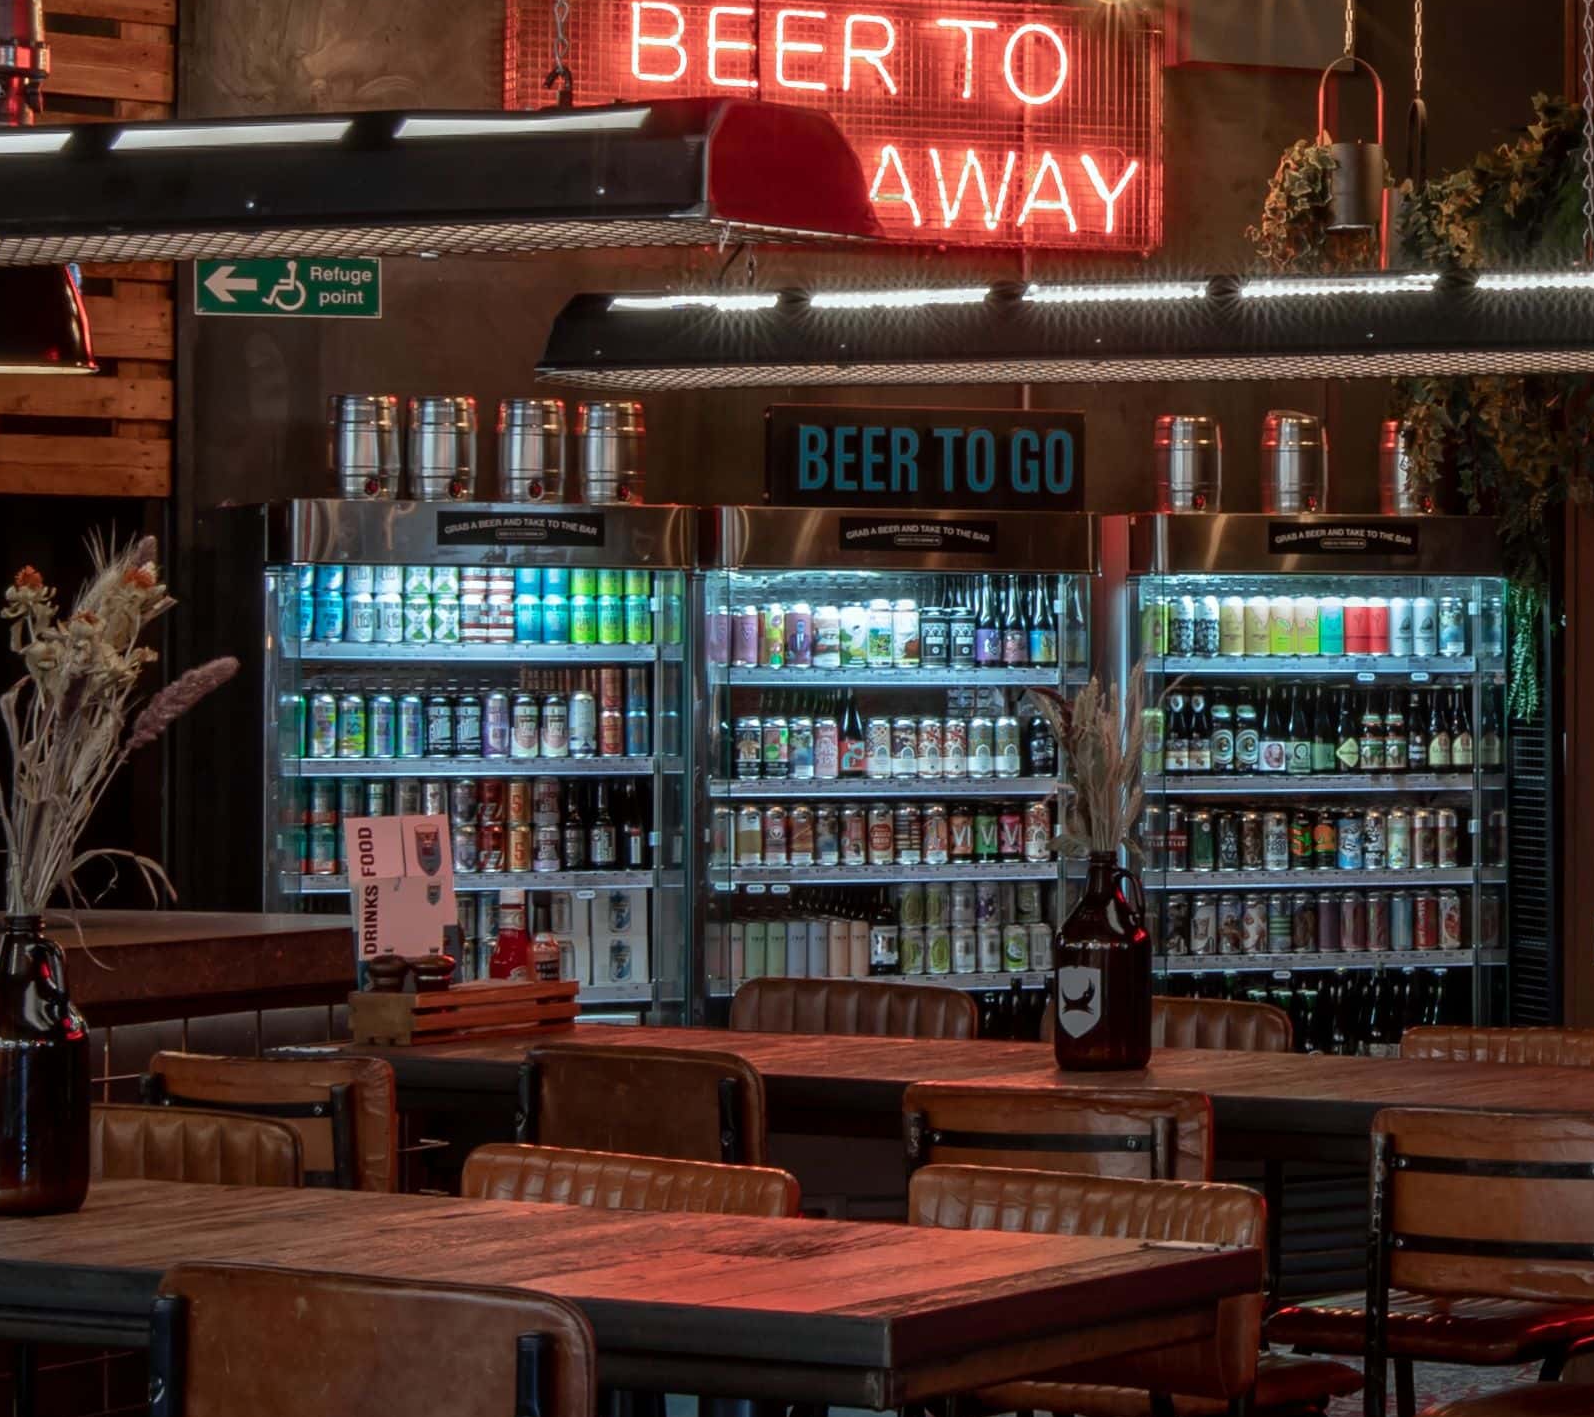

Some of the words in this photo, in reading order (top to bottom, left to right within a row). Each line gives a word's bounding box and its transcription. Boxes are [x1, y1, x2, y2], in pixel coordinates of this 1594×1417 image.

[629, 1, 898, 96] BEER
[935, 18, 1070, 106] TO
[869, 144, 1140, 235] AWAY
[309, 266, 373, 284] Refuge
[318, 289, 365, 308] point
[797, 423, 921, 493] BEER
[932, 426, 997, 494] TO
[1009, 428, 1075, 496] GO
[444, 523, 471, 534] GRAB
[478, 519, 502, 529] BEER
[503, 518, 522, 527] AND
[523, 518, 546, 527] TAKE
[547, 519, 559, 528] TO
[561, 521, 578, 532] THE
[579, 525, 598, 535] BAR
[845, 528, 870, 539] GRAB
[878, 525, 900, 533] BEER
[901, 524, 919, 533] AND
[920, 525, 941, 533] TAKE
[942, 526, 955, 535] TO
[956, 528, 972, 539] THE
[972, 532, 991, 542] BAR
[1274, 533, 1298, 544] GRAB
[1306, 529, 1327, 538] BEER
[1327, 528, 1345, 536] AND
[1346, 528, 1366, 537] TAKE
[1367, 530, 1378, 538] TO
[1379, 532, 1395, 540] THE
[1395, 535, 1412, 545] BAR
[357, 827, 377, 877] FOOD
[363, 884, 379, 955] DRINKS
